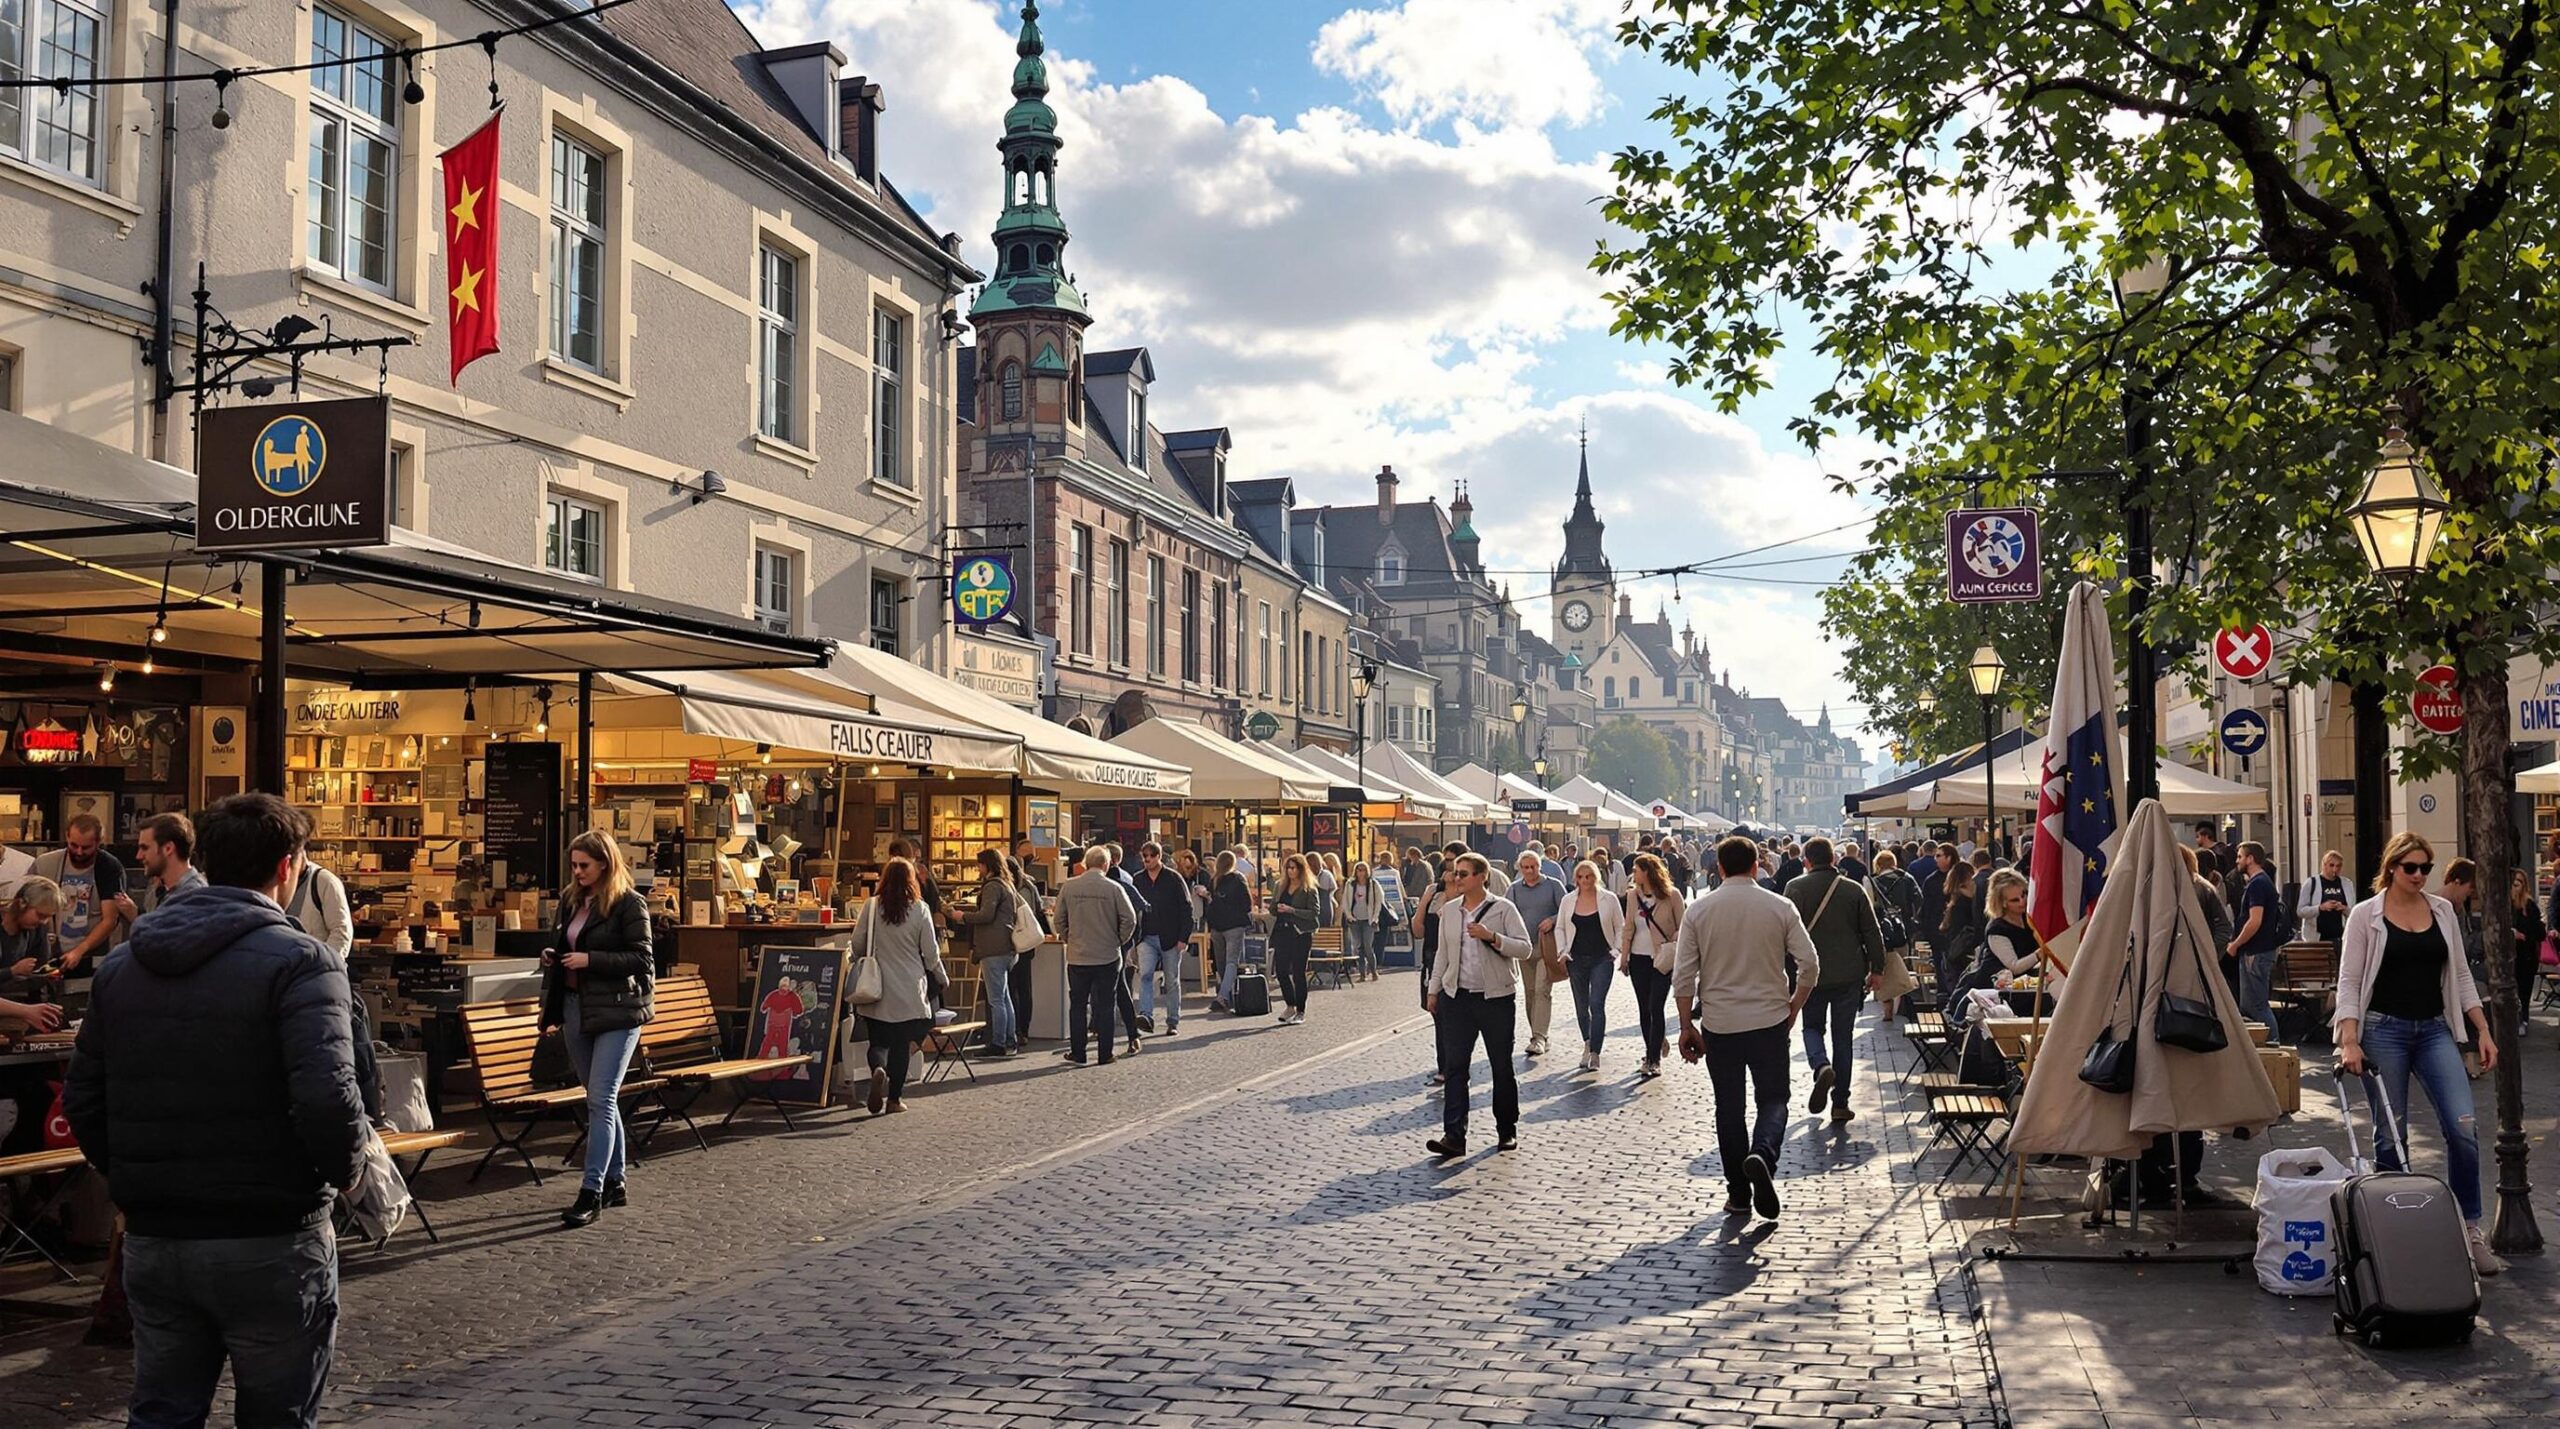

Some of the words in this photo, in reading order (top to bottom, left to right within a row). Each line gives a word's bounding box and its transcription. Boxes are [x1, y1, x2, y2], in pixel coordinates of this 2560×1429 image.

[215, 502, 361, 532] OLDERGIUNE
[830, 723, 873, 755] FALLS
[876, 730, 932, 760] CEAUER
